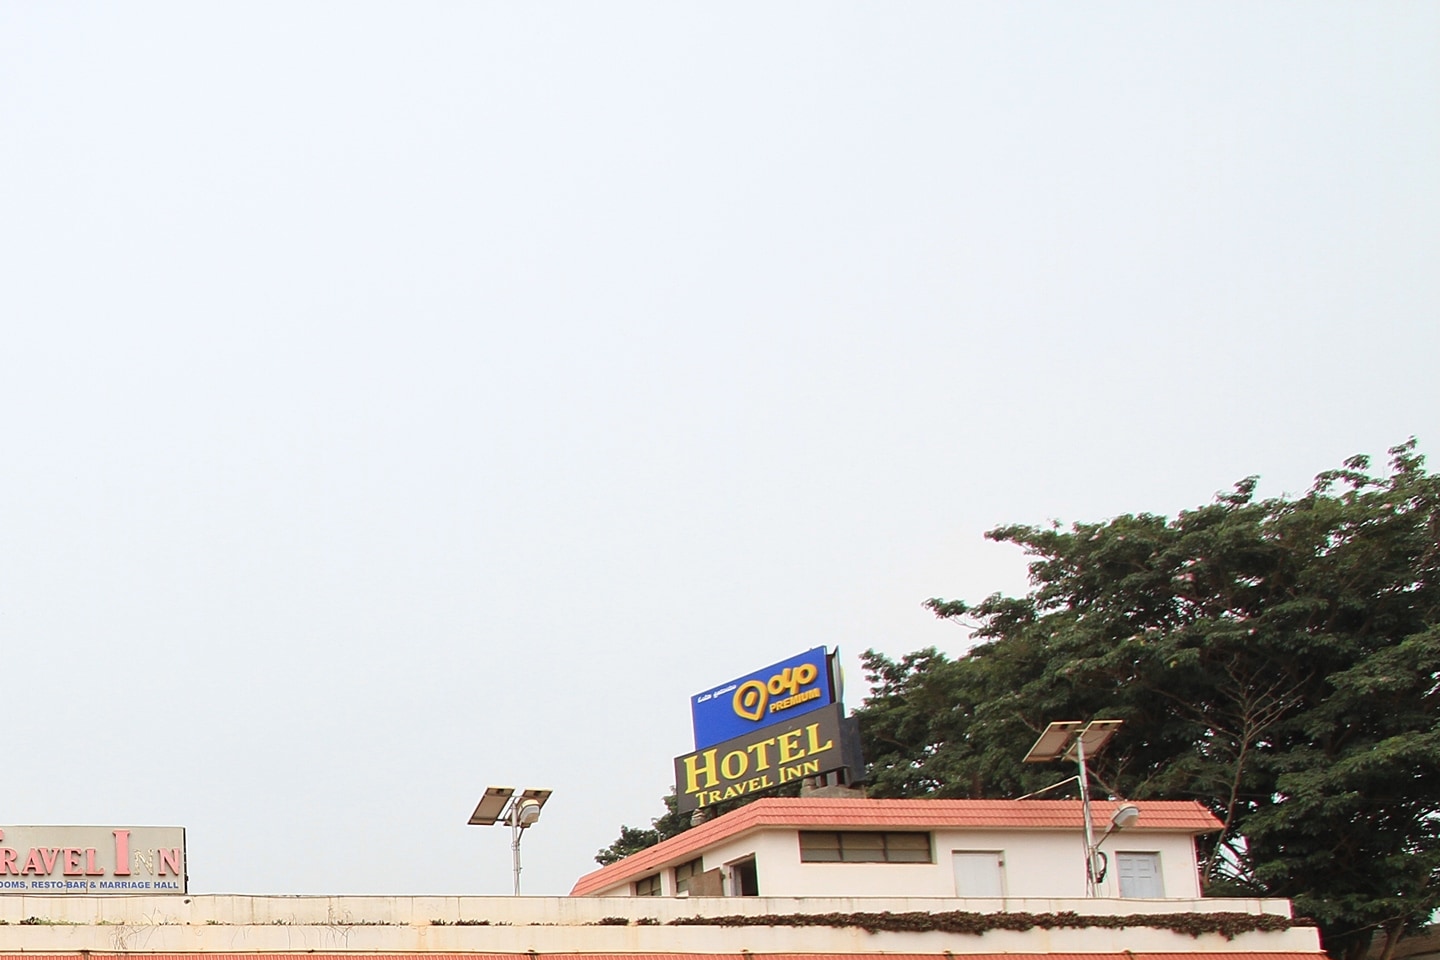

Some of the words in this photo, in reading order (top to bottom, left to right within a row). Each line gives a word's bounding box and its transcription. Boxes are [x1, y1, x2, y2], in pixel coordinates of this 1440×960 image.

[769, 688, 821, 713] PREMIUM
[683, 723, 833, 794] HOTEL
[695, 775, 774, 808] TRAVEL
[777, 759, 819, 784] INN
[112, 829, 181, 877] INN
[31, 880, 87, 889] RESTO-BAR
[89, 880, 97, 889] &
[99, 880, 151, 889] MARRIAGE
[153, 880, 179, 889] HALL
